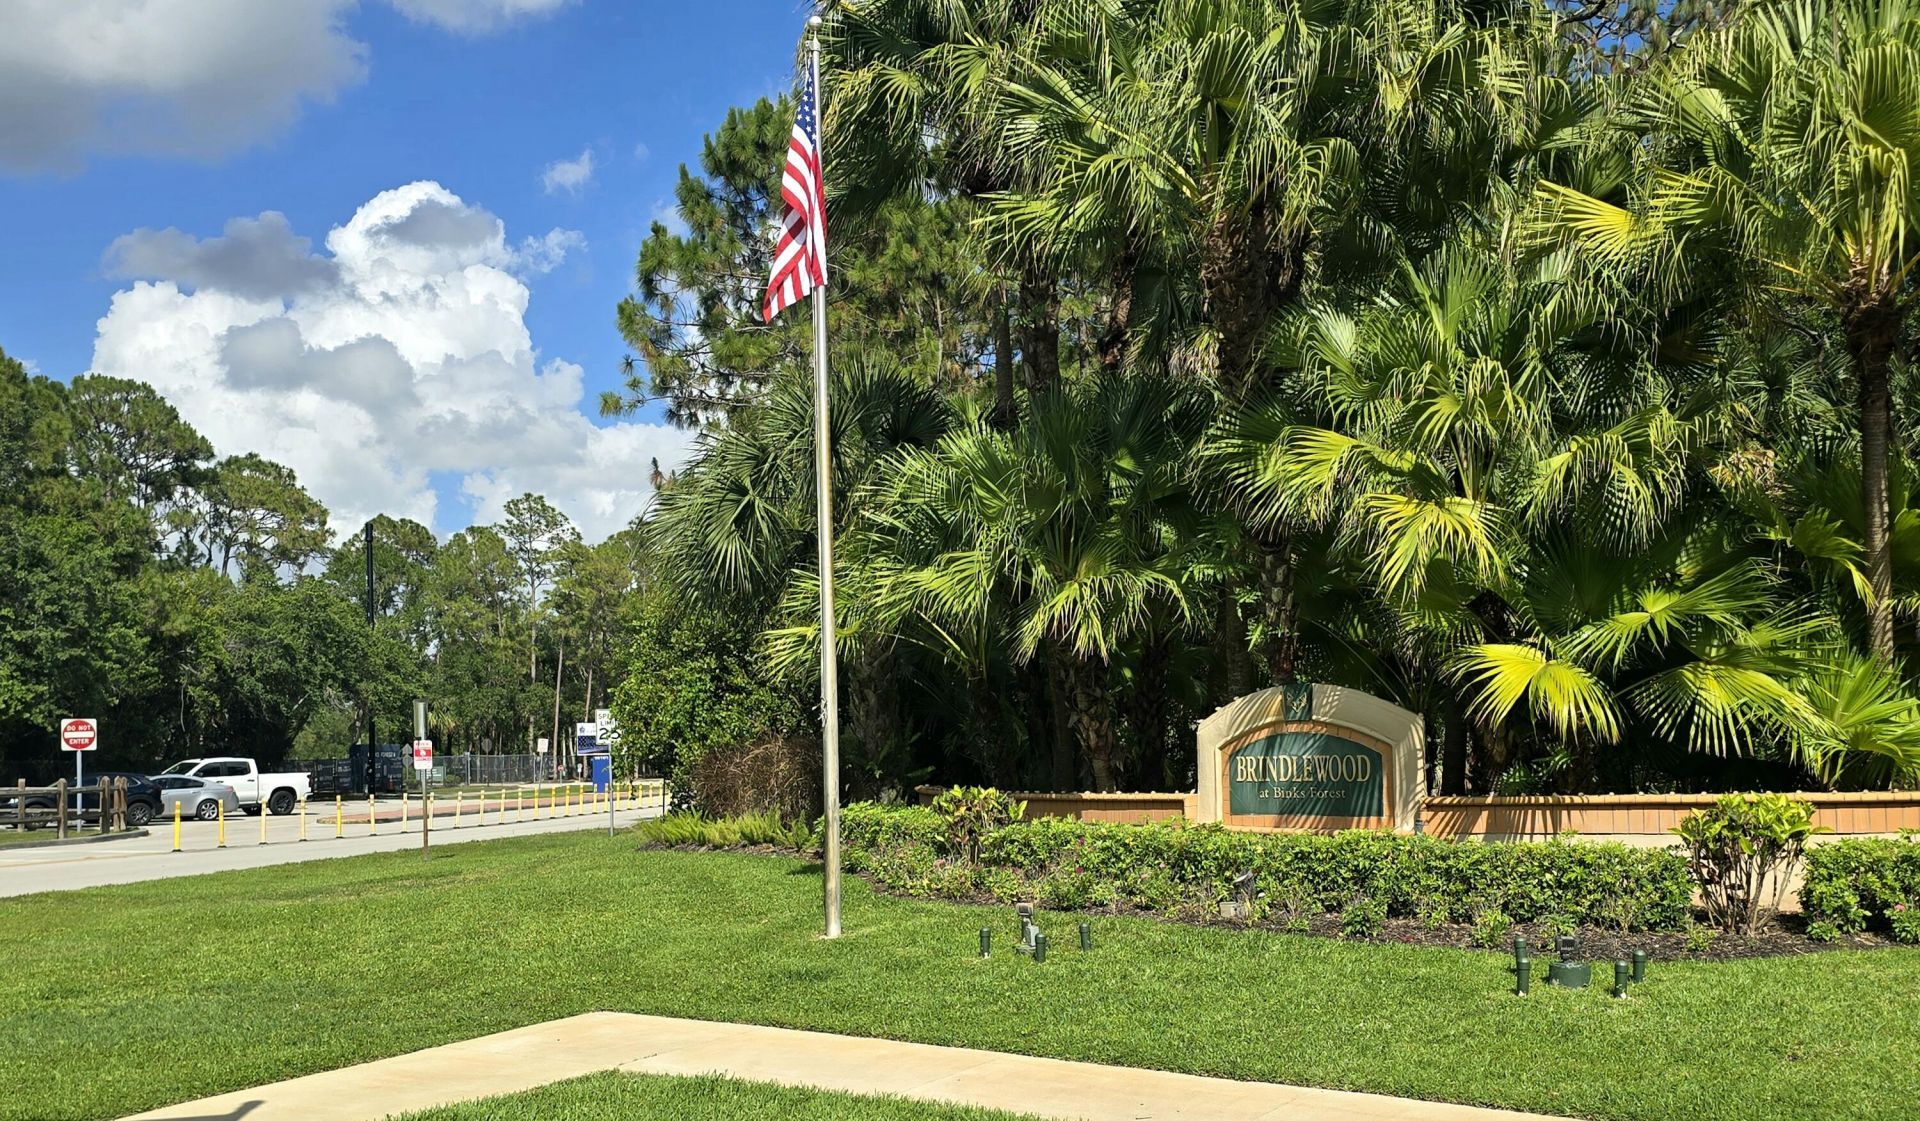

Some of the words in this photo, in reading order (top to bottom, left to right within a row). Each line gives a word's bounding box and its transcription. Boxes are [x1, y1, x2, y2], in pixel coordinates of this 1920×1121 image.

[1236, 754, 1371, 783] BRINDLEWOOD
[1259, 789, 1269, 798] at
[1274, 787, 1306, 798] Binks
[1310, 787, 1346, 799] Forest
